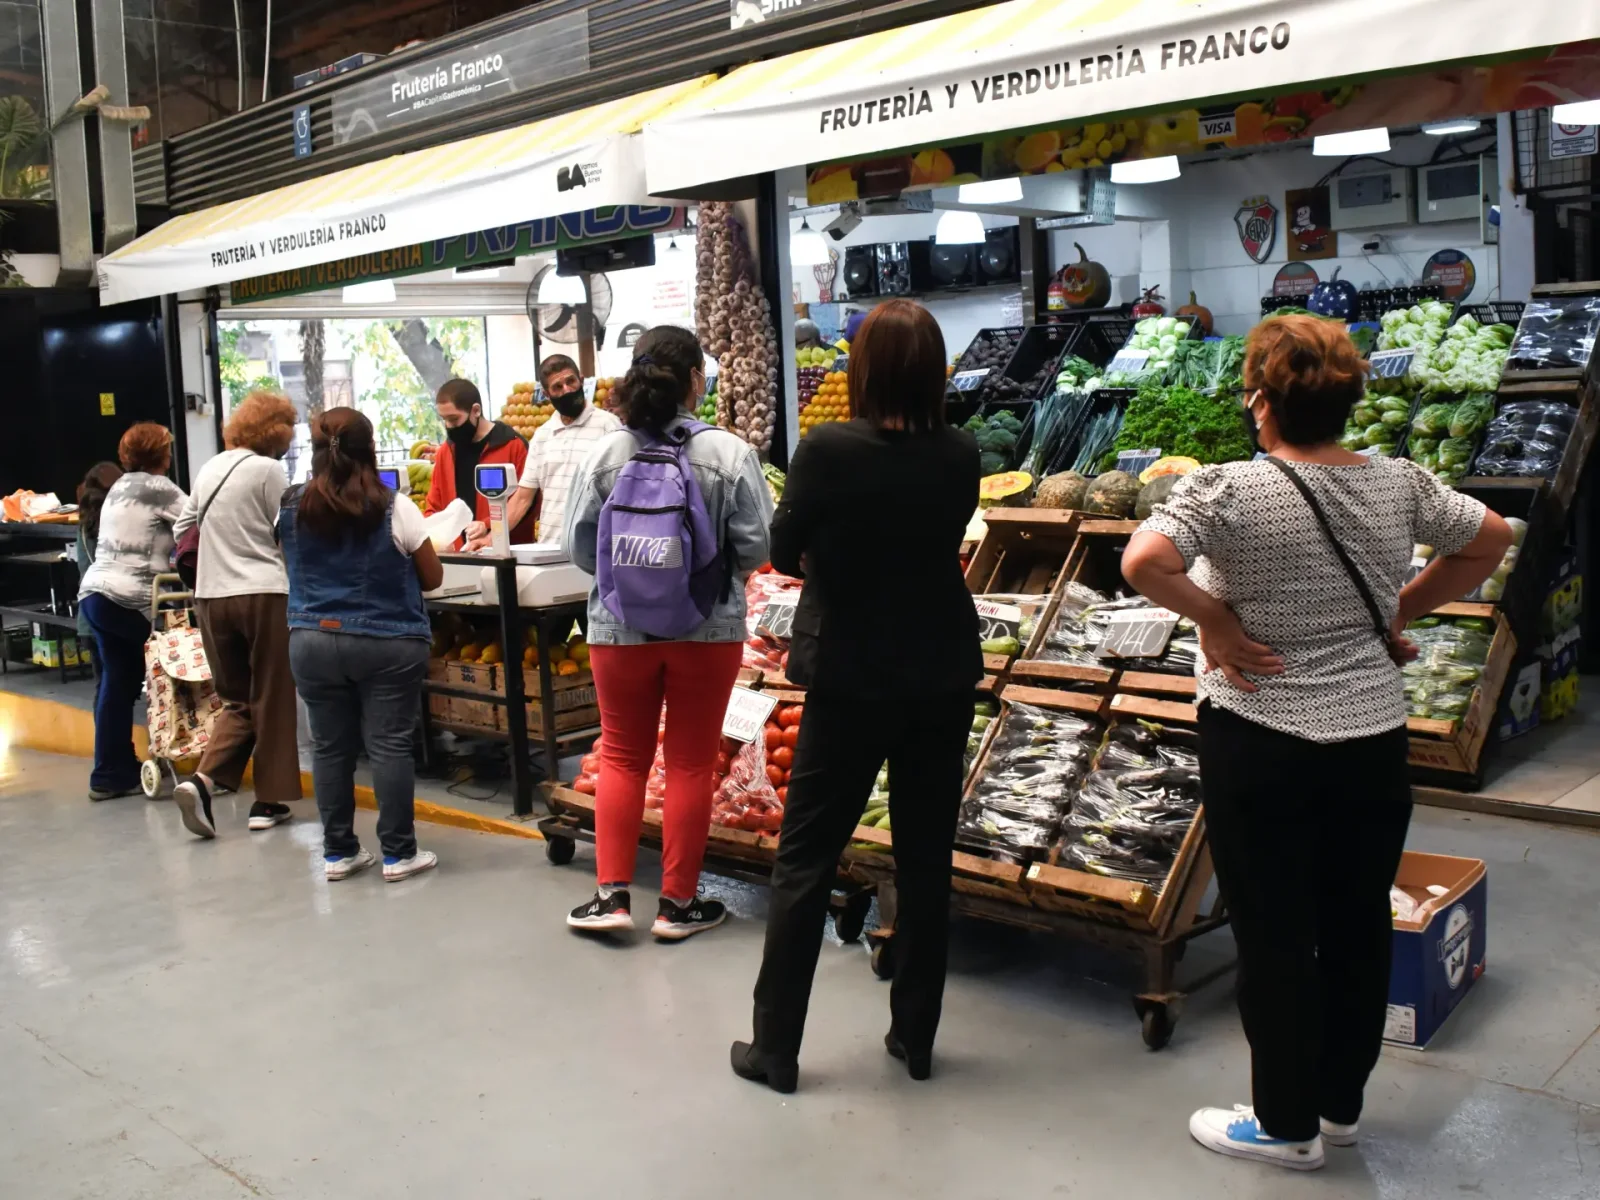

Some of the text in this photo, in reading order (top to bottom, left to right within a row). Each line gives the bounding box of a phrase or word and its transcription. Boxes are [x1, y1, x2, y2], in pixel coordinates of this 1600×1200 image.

[392, 54, 503, 103] Frutería Franco
[819, 21, 1291, 134] FRUTERÍA Y VERDULERÍA FRANCO
[1203, 121, 1232, 135] VISA
[210, 213, 386, 268] FRUTERÍA Y VERDULERÍA FRANCO
[611, 535, 671, 568] NIKE
[725, 712, 757, 735] TOCAR
